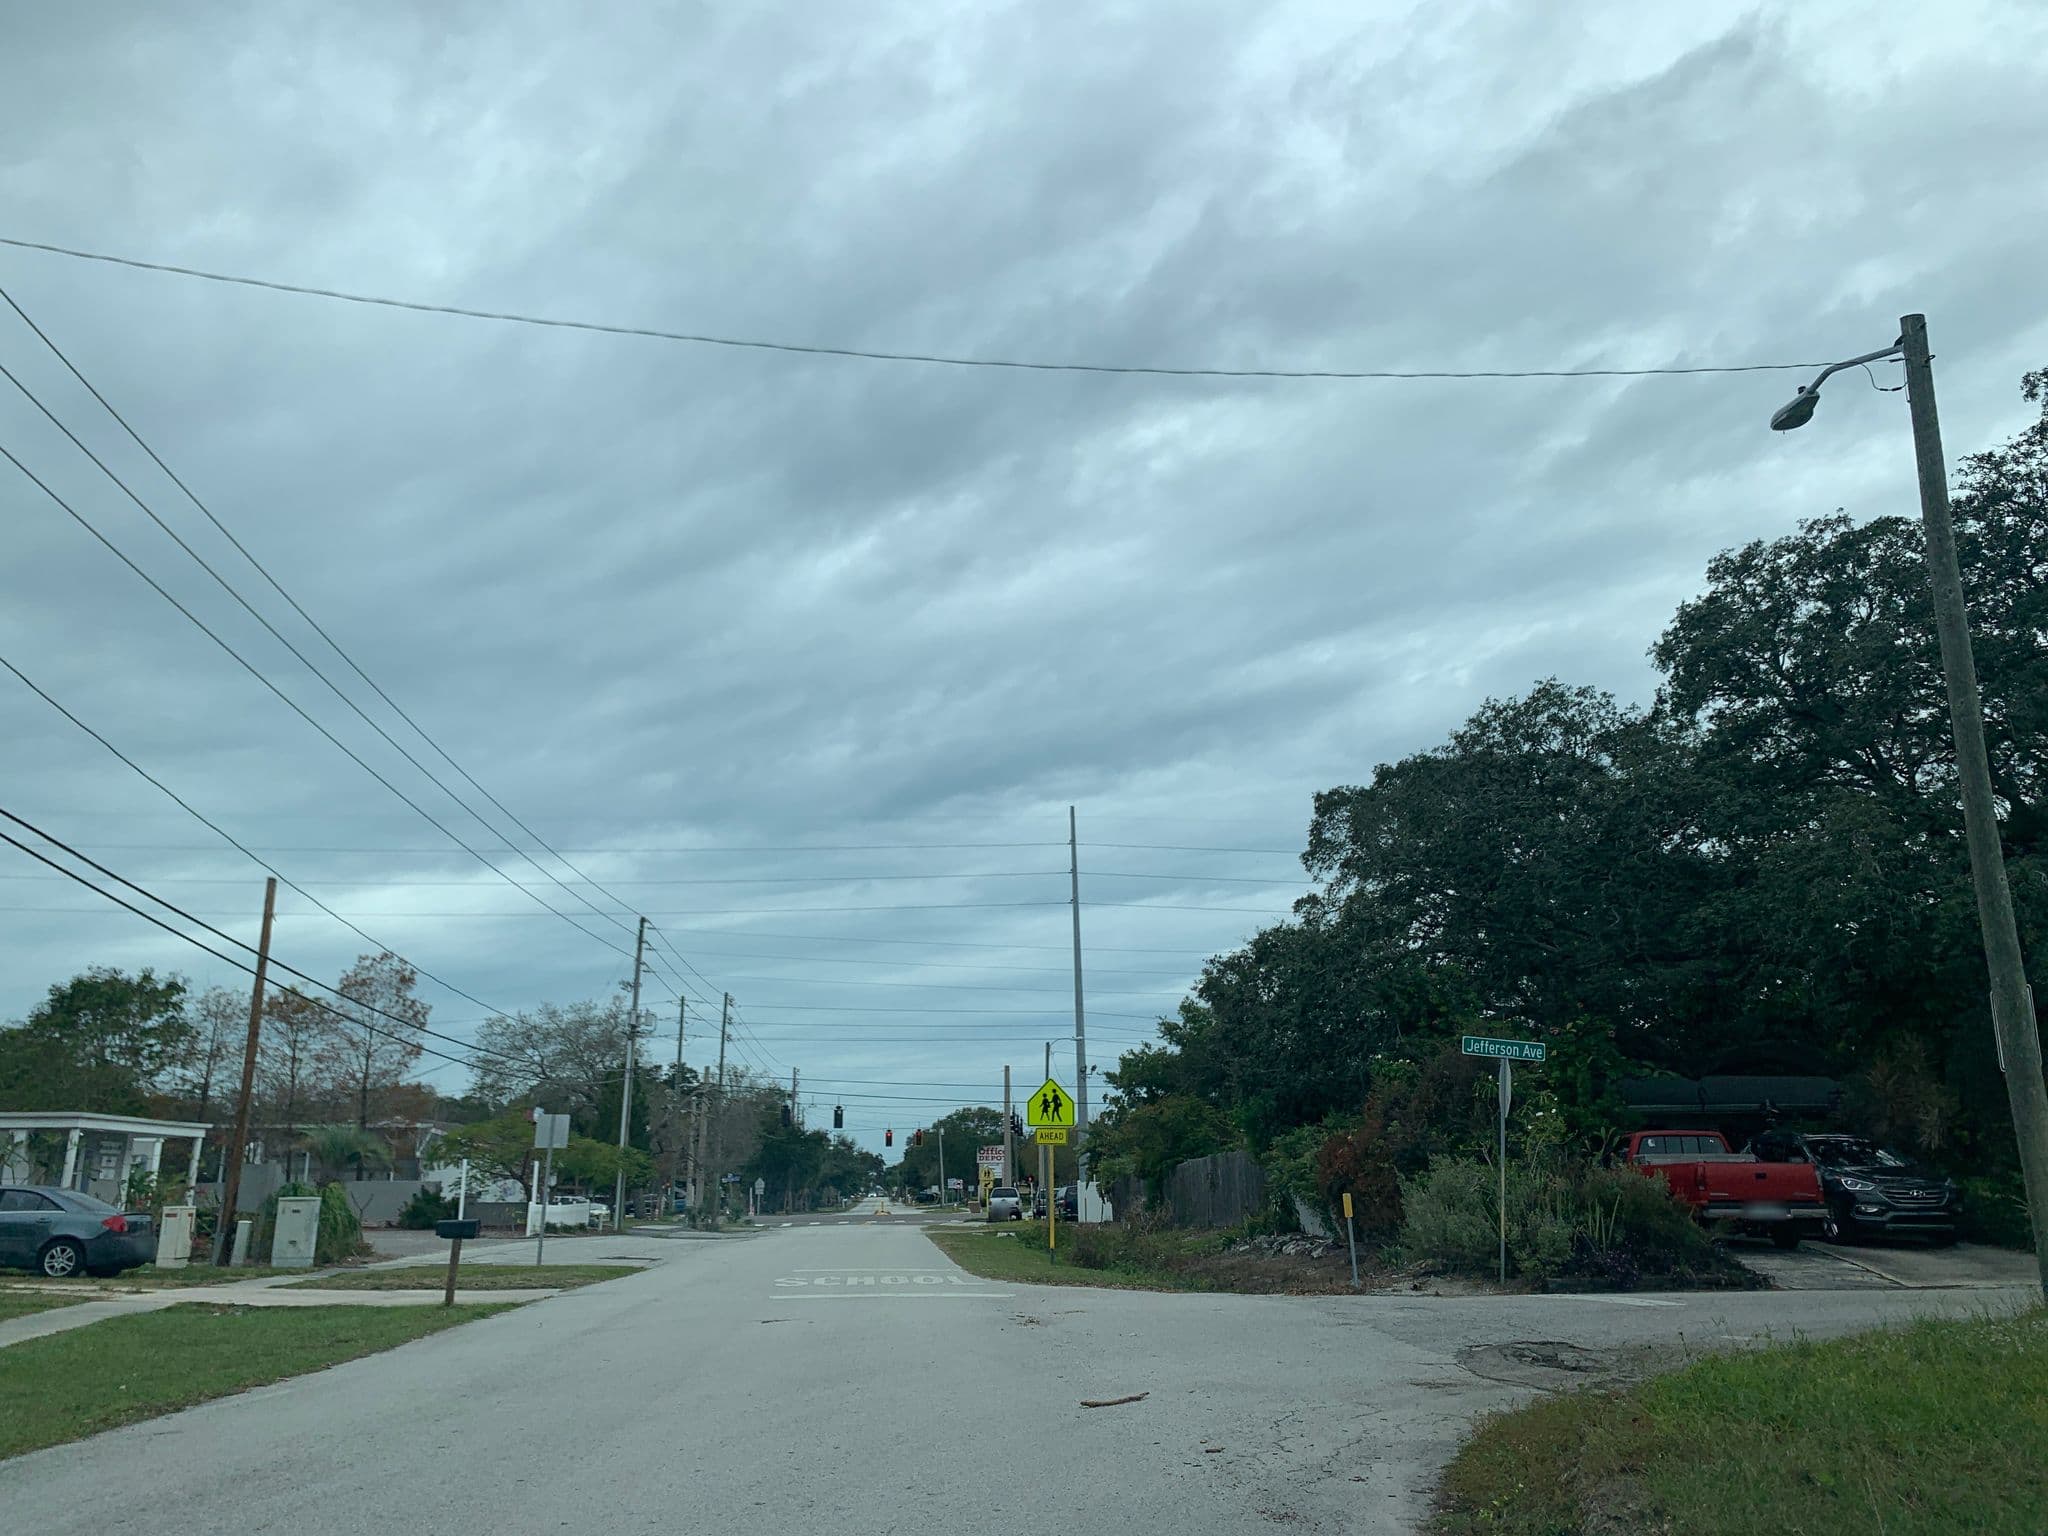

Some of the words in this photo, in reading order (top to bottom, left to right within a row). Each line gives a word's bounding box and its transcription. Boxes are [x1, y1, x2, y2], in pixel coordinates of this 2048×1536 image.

[1467, 1040, 1519, 1056] Jefferson
[1522, 1045, 1543, 1058] Ave
[1040, 1132, 1064, 1140] AHEAD
[774, 1275, 985, 1287] SCHOOL
